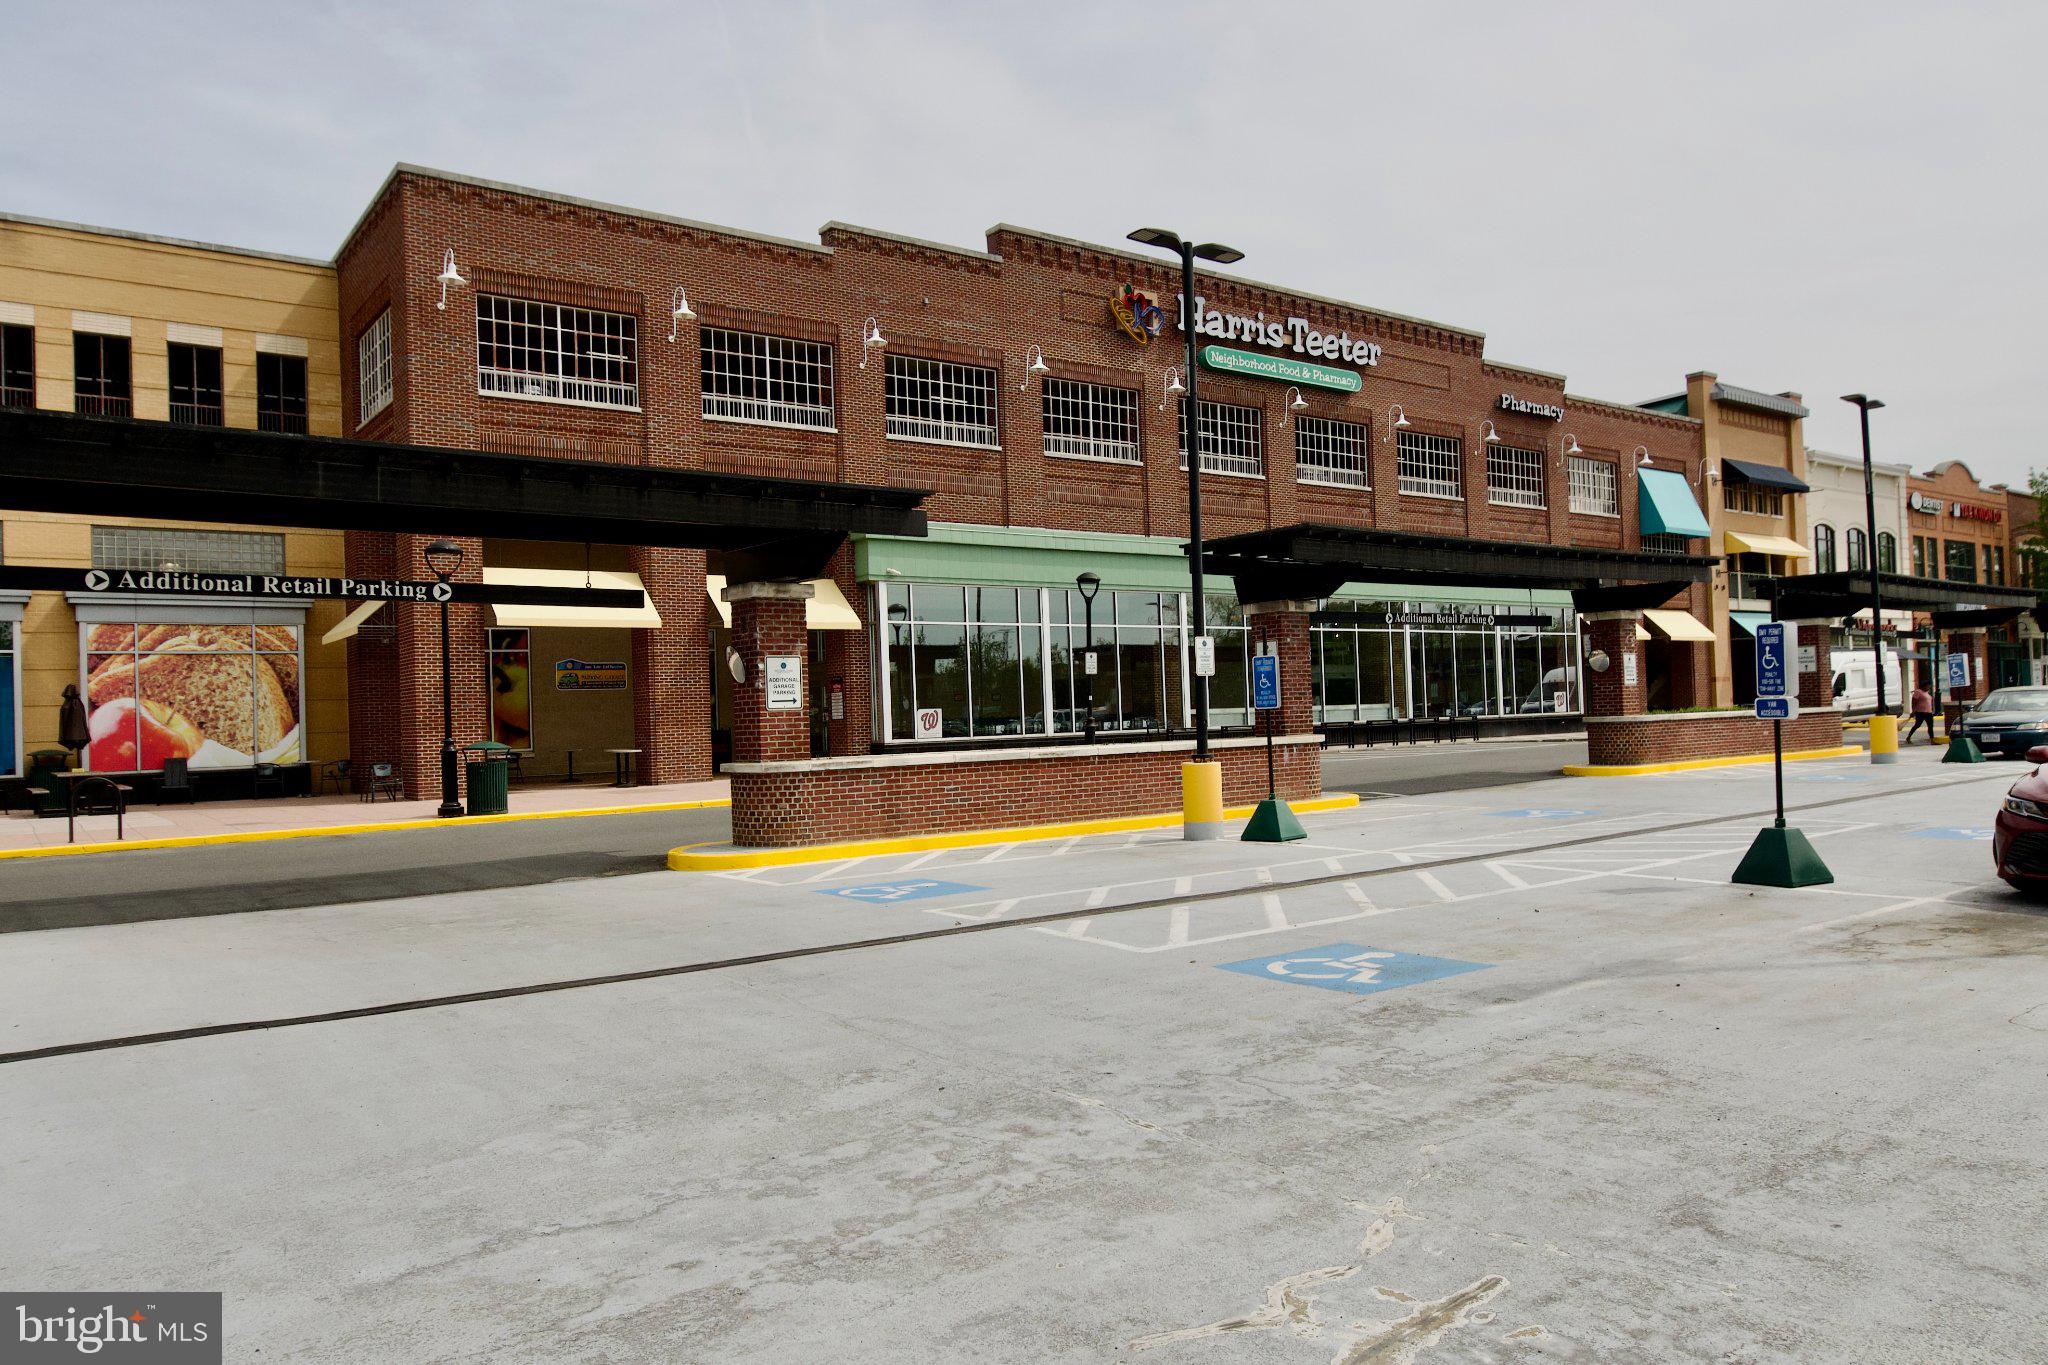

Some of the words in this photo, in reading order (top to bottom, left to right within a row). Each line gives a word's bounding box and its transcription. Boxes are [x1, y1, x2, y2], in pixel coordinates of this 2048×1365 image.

[1177, 294, 1284, 348] Harris
[1288, 316, 1382, 366] Teeter
[1211, 350, 1277, 374] Neighborhood
[1279, 364, 1300, 378] Food
[1302, 367, 1311, 379] &
[1313, 370, 1358, 391] Pharmacy
[1501, 393, 1565, 423] Pharmacy
[117, 570, 252, 593] Additional
[262, 576, 331, 596] Retail
[339, 579, 428, 601] Parking
[1394, 612, 1434, 624] Additional
[1436, 613, 1458, 624] Retail
[1459, 614, 1487, 626] Parking
